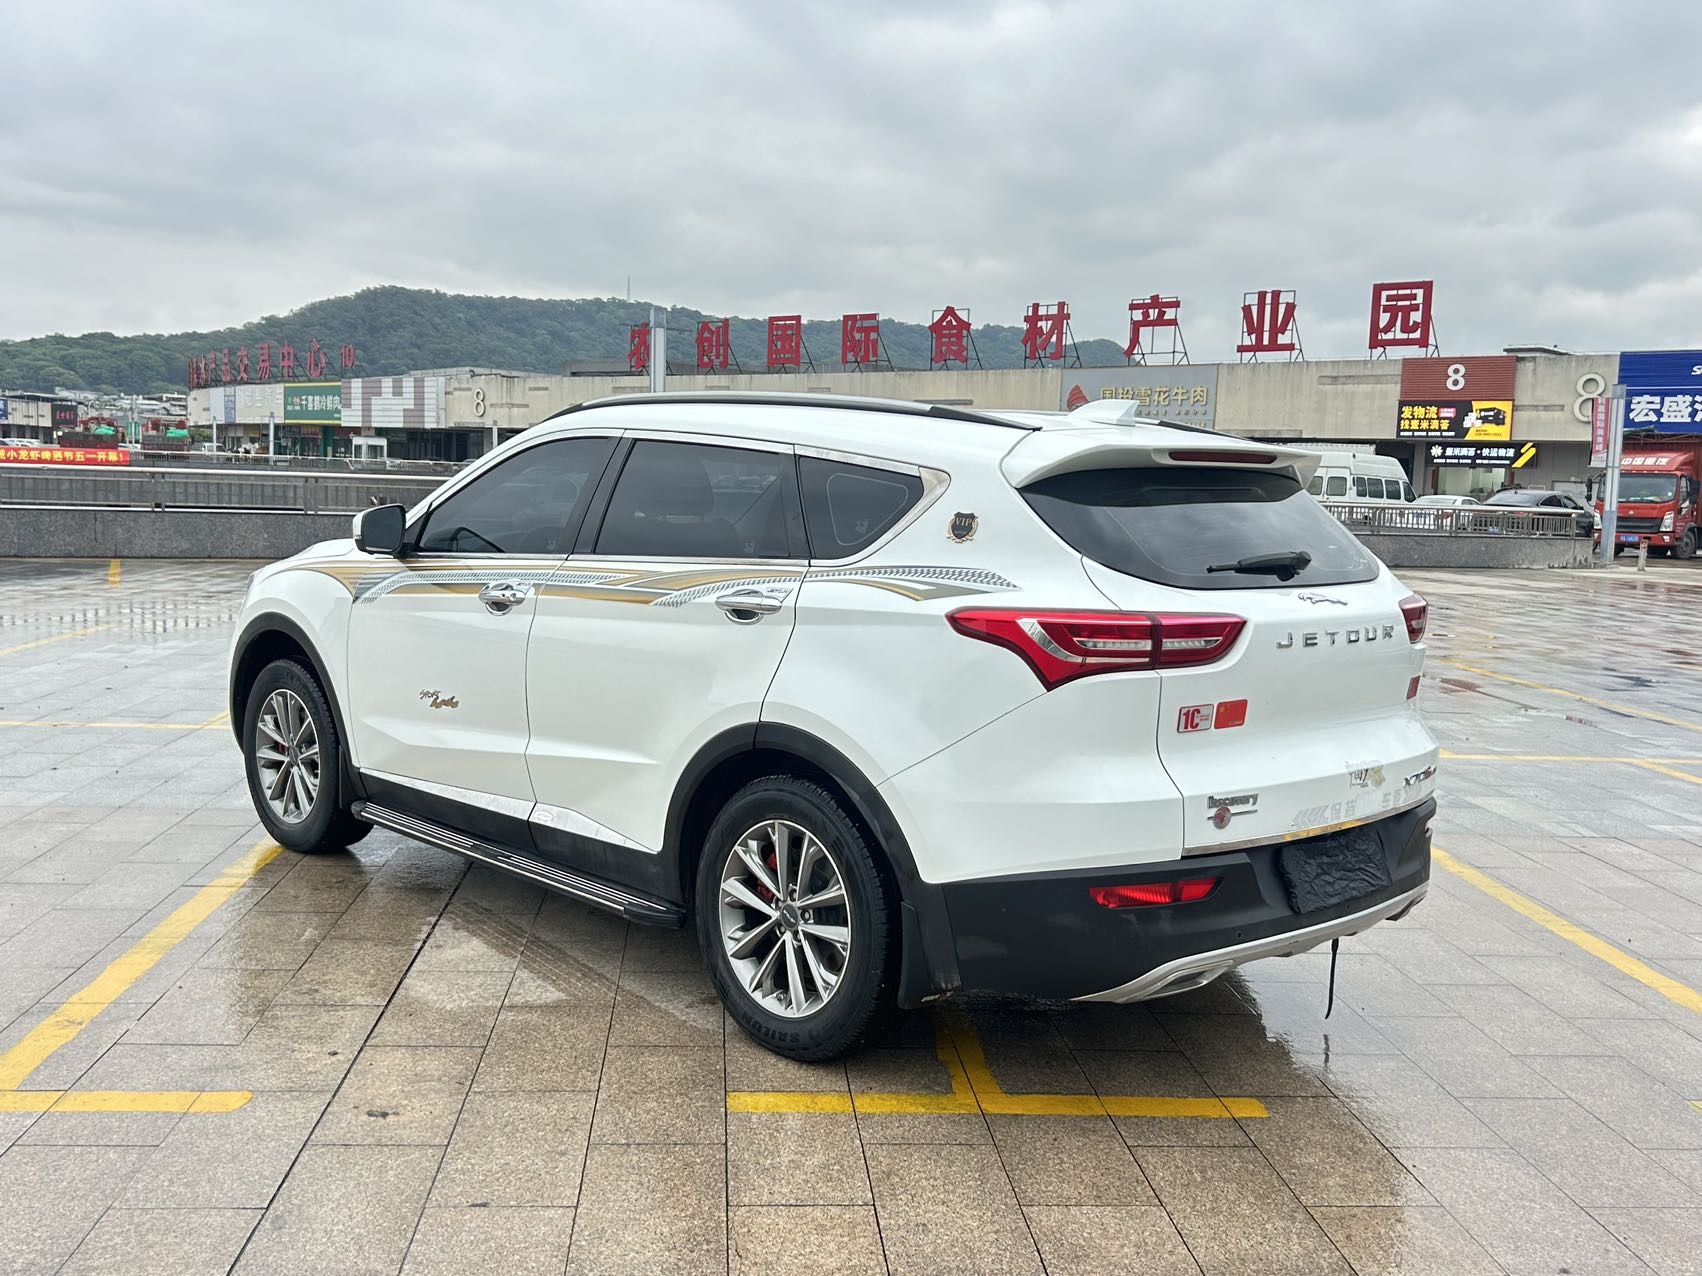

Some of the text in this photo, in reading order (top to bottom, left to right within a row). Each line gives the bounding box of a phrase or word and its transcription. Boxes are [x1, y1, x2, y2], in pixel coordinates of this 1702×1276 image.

[1446, 363, 1466, 391] 8
[474, 388, 485, 417] 8
[1400, 405, 1438, 419] 发物流
[1629, 394, 1702, 423] 宏盛
[1276, 624, 1395, 649] JETOUR
